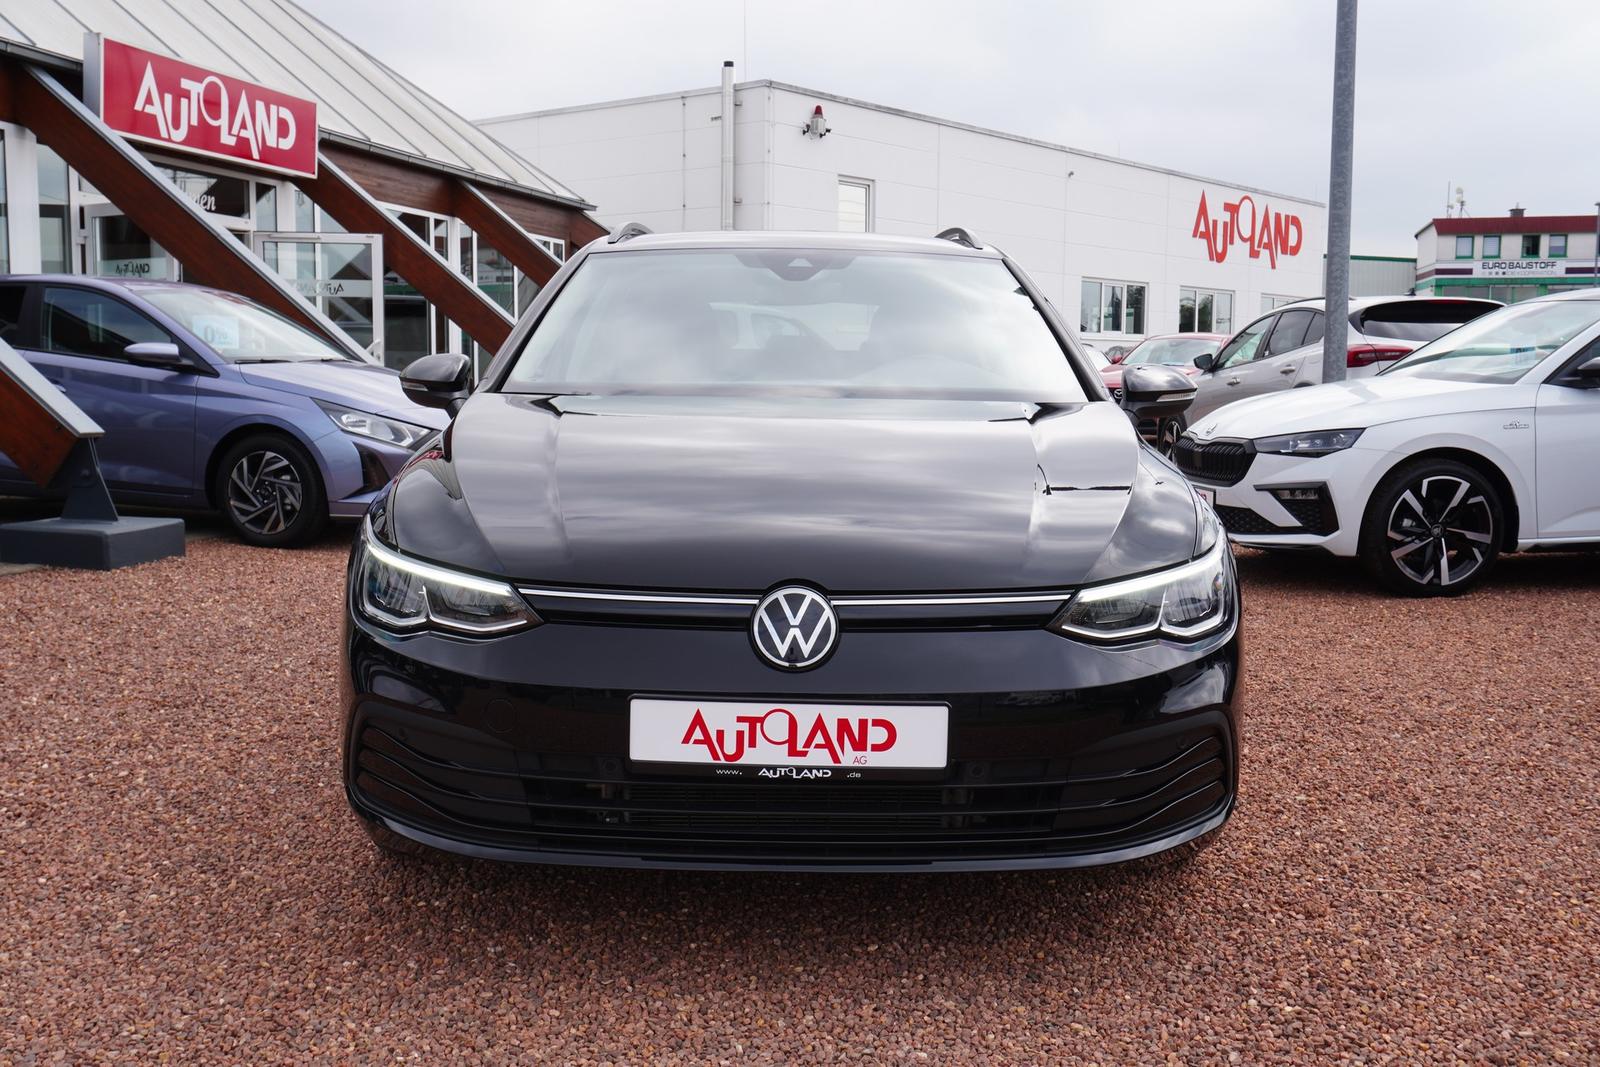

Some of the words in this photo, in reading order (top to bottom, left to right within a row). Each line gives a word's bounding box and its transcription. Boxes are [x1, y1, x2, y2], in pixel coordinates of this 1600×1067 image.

[134, 60, 296, 160] AUTOLAND
[1192, 189, 1302, 269] AUTOLAND
[681, 708, 897, 764] AUTOLAND
[853, 756, 867, 765] AG
[758, 767, 832, 778] AUTOLAND
